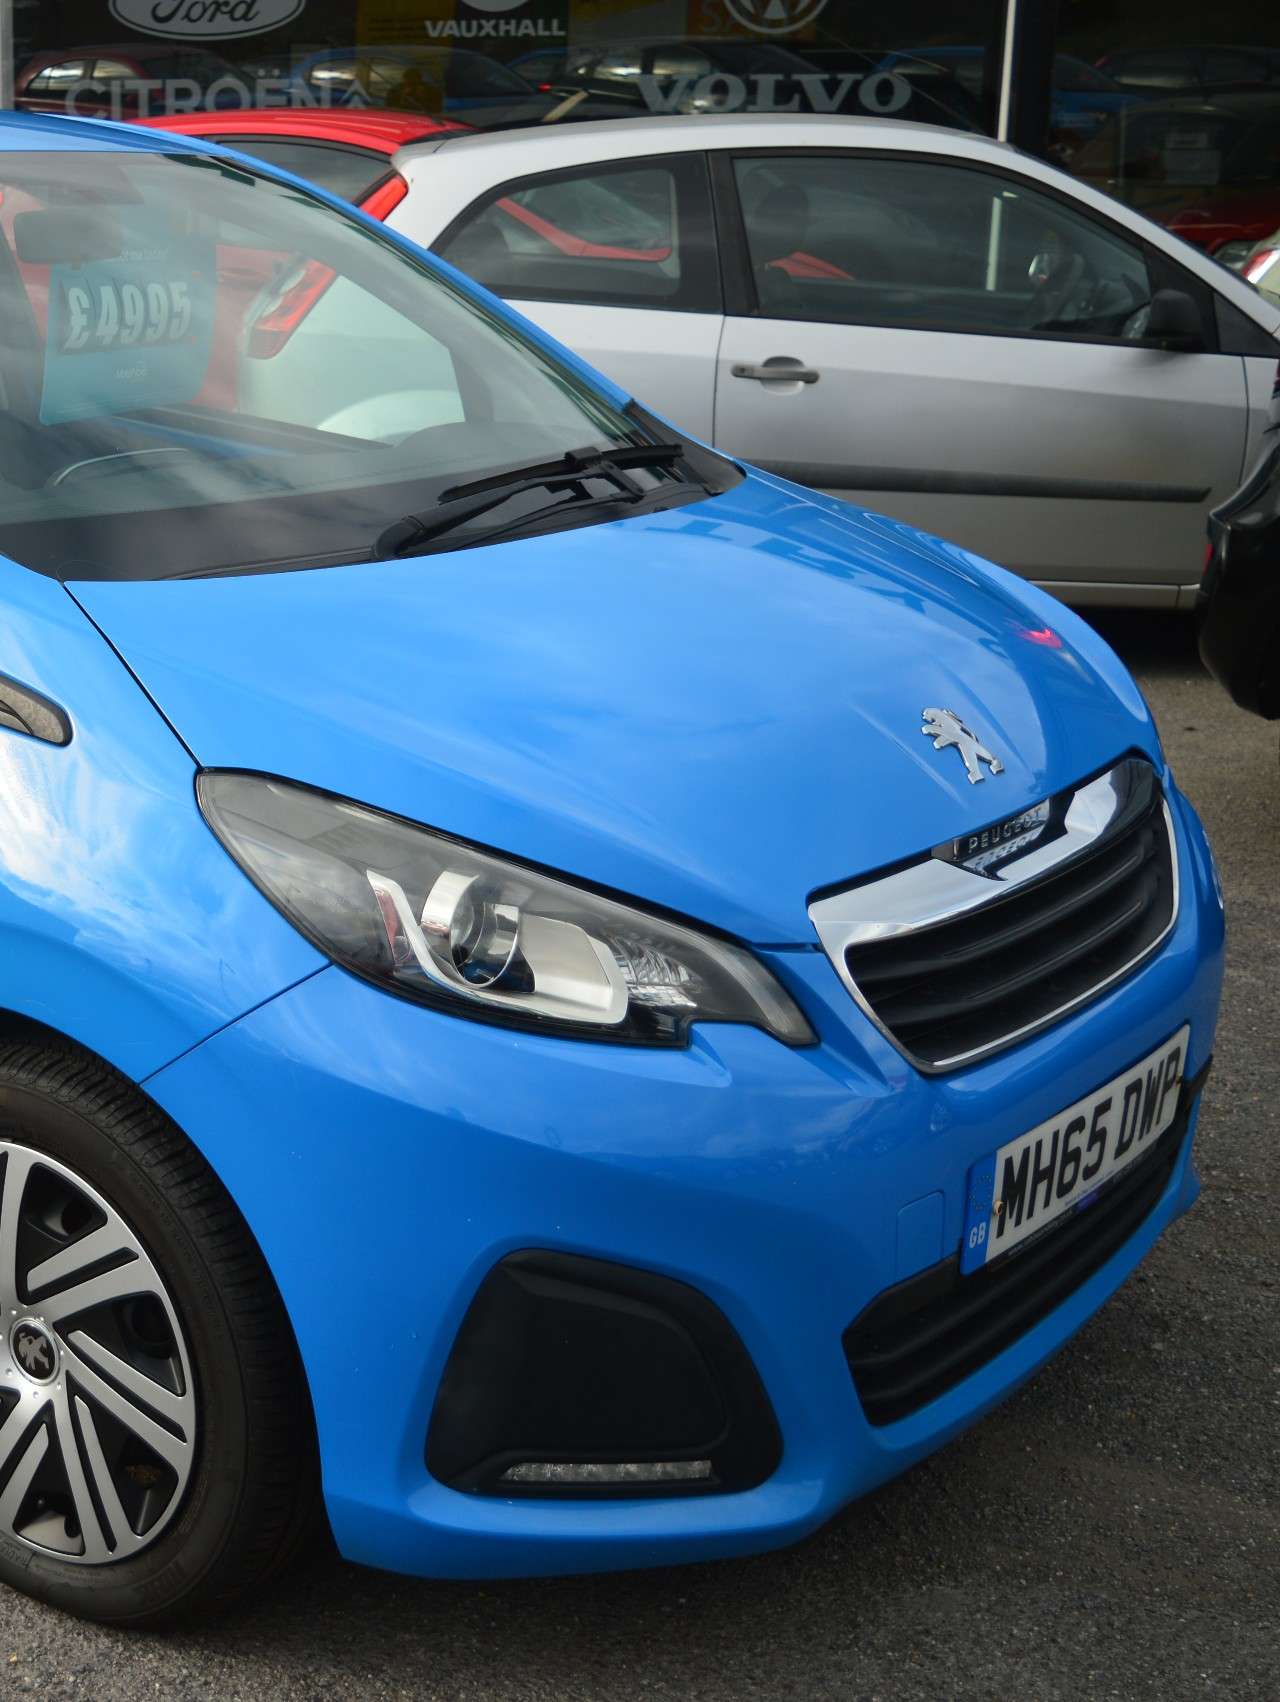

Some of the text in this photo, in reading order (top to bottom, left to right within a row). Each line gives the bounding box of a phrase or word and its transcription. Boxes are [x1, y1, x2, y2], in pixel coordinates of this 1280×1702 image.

[425, 19, 566, 39] VAUXHALL
[64, 68, 332, 120] CITROËN
[637, 73, 913, 113] VOLVO
[64, 281, 192, 350] £4995
[995, 1046, 1182, 1240] MH65 DWP
[969, 1221, 987, 1249] GB
